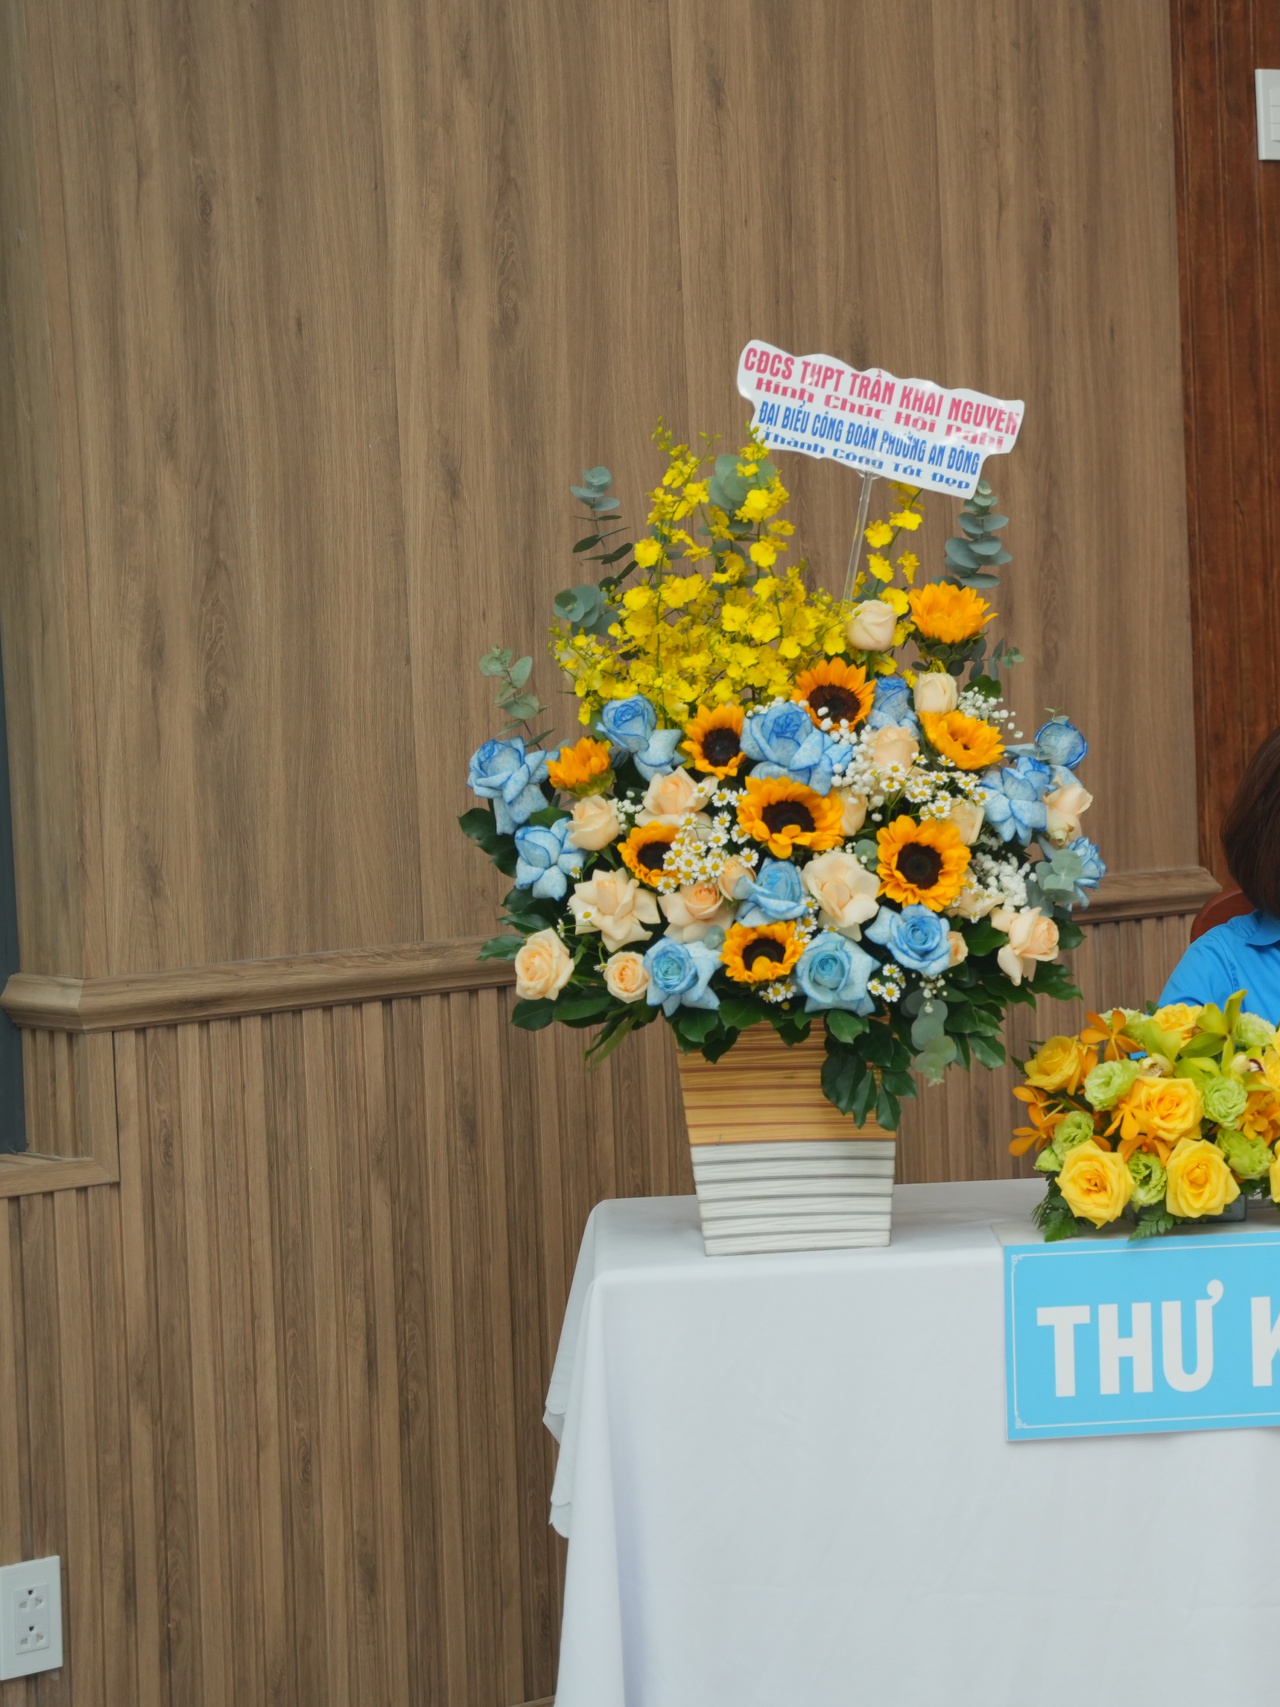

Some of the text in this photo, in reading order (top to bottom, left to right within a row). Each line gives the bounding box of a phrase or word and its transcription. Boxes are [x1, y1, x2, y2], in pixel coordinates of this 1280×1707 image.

[744, 347, 795, 380] CĐCS
[800, 360, 845, 392] THPT
[899, 385, 944, 417] KHAI
[755, 377, 814, 403] Kính
[824, 394, 886, 421] Chúc
[894, 411, 936, 433] Hội
[811, 411, 844, 442] CÔNG
[845, 421, 879, 451] ĐOÀN
[928, 443, 946, 467] AN
[947, 445, 980, 475] ĐÔNG
[832, 448, 884, 469] Công
[893, 462, 924, 478] Tốt
[931, 472, 970, 489] Đẹp
[1036, 1279, 1224, 1398] THƯ
